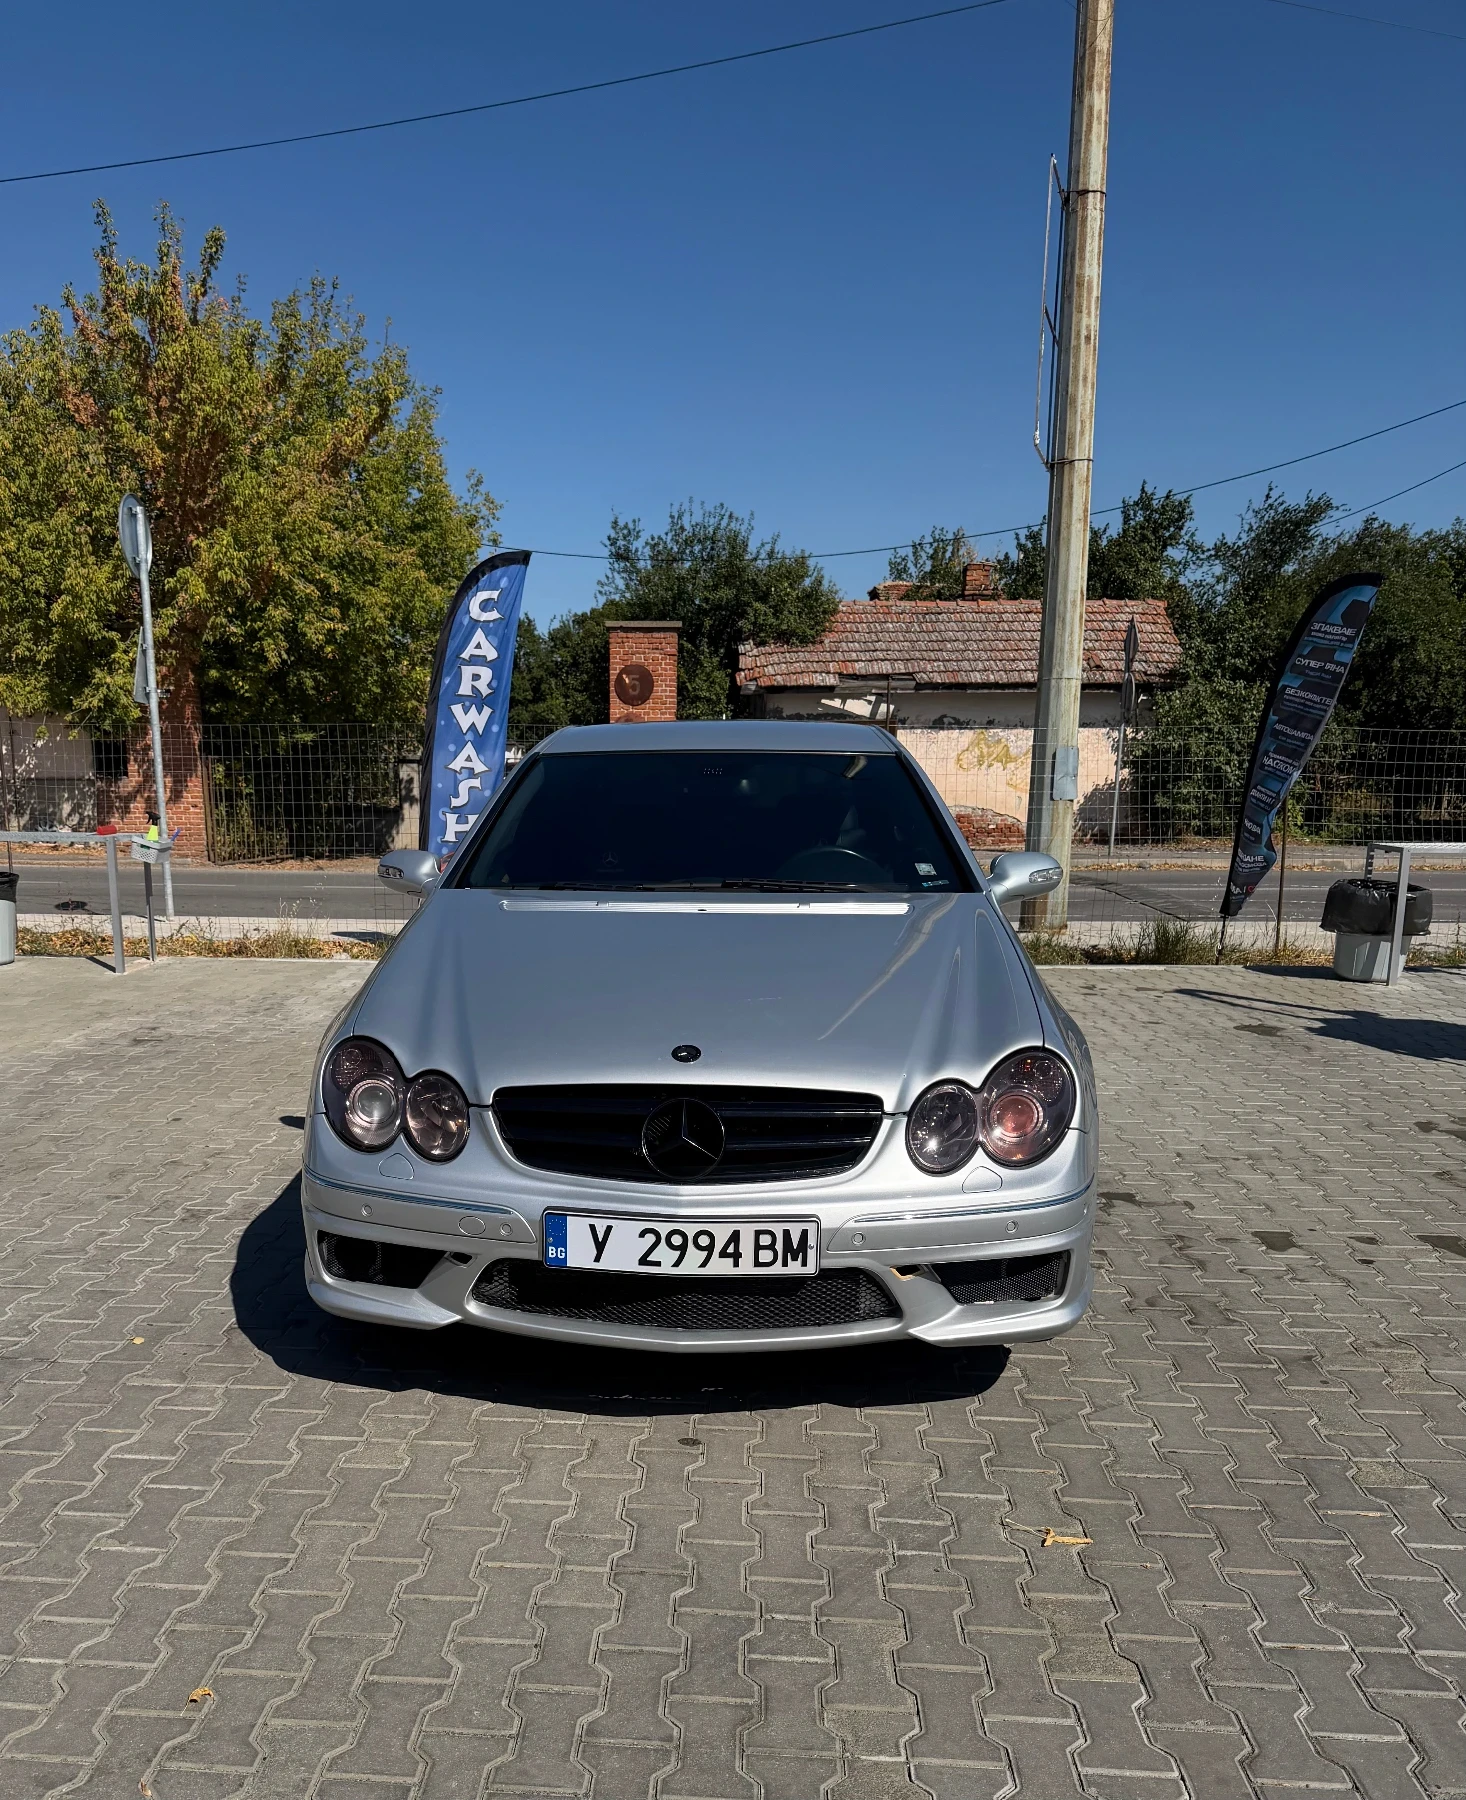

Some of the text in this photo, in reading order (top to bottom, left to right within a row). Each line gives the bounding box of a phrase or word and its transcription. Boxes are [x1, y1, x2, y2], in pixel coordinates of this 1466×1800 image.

[1295, 657, 1324, 669] СУПЕР
[443, 588, 504, 842] CARWASH
[548, 1246, 566, 1259] BG
[637, 1227, 742, 1268] 2994
[753, 1228, 809, 1268] BM
